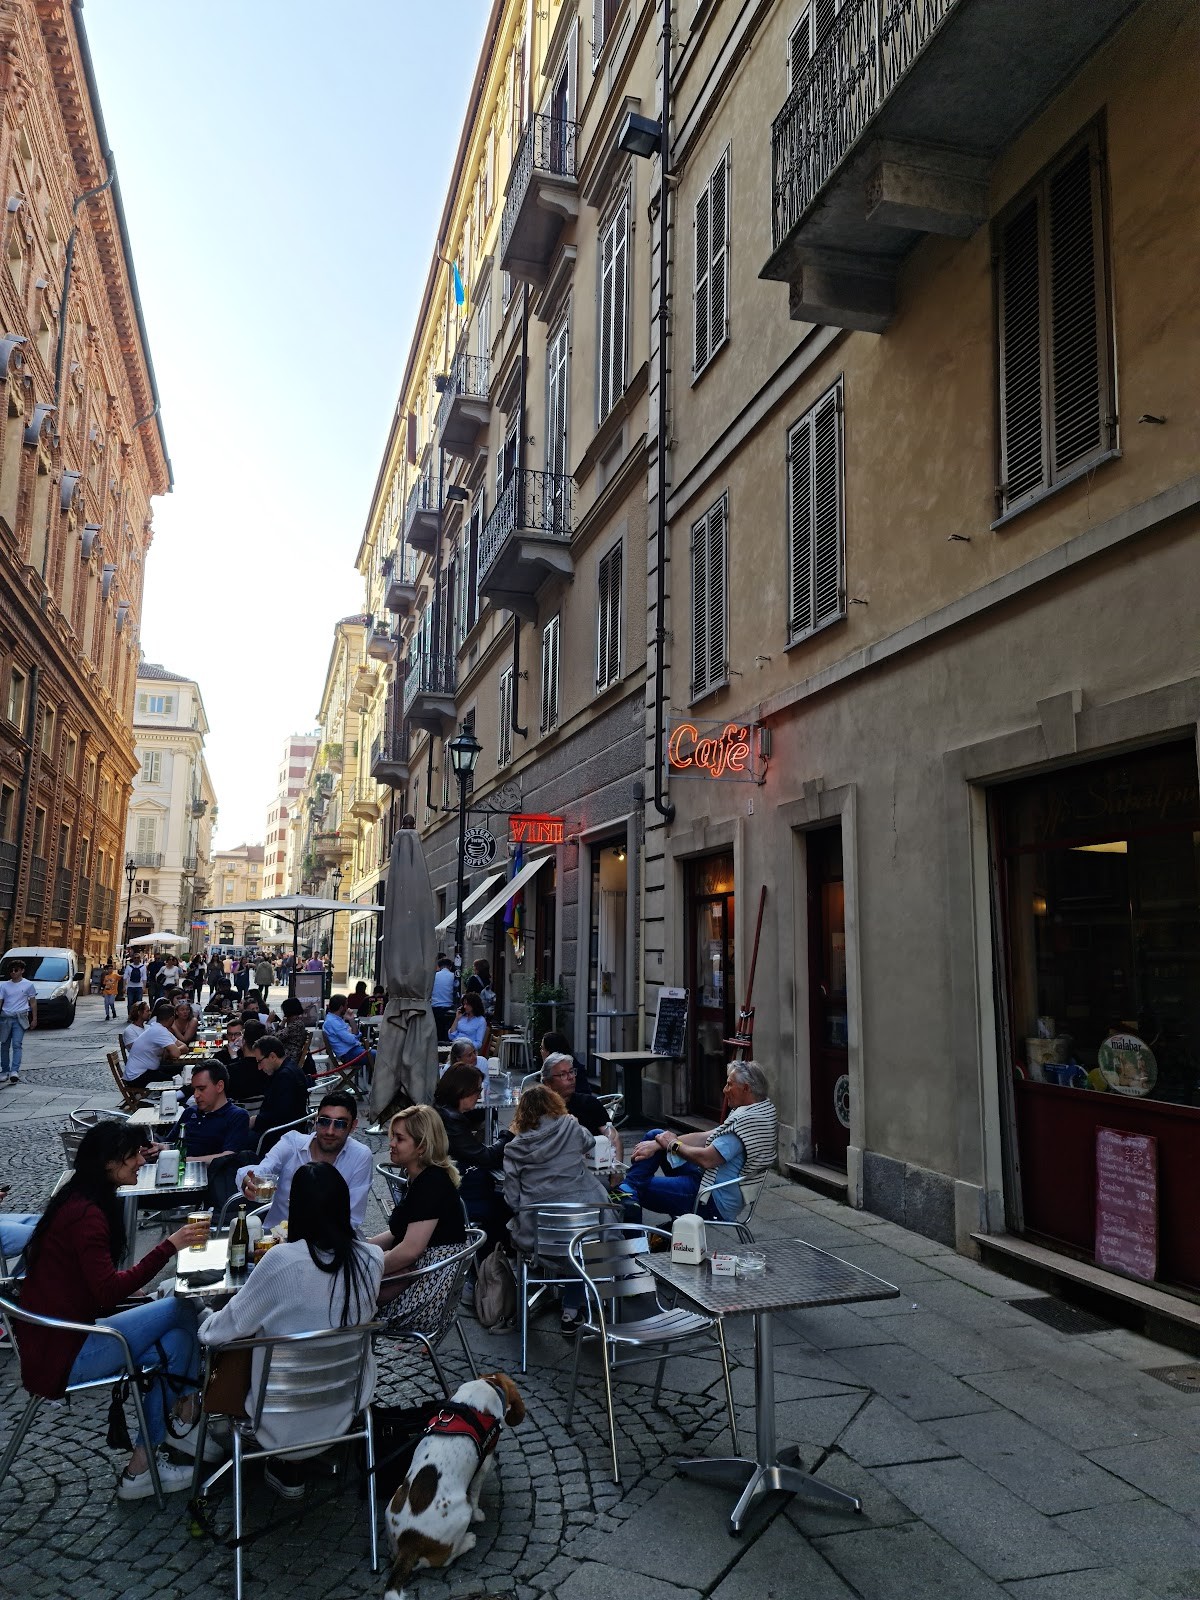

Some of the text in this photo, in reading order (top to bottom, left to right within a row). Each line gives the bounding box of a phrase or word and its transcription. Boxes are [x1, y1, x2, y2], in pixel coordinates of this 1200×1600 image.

[668, 724, 750, 777] Café
[511, 821, 563, 842] VINI
[463, 855, 491, 865] COFFEE
[1111, 1039, 1142, 1052] malabar
